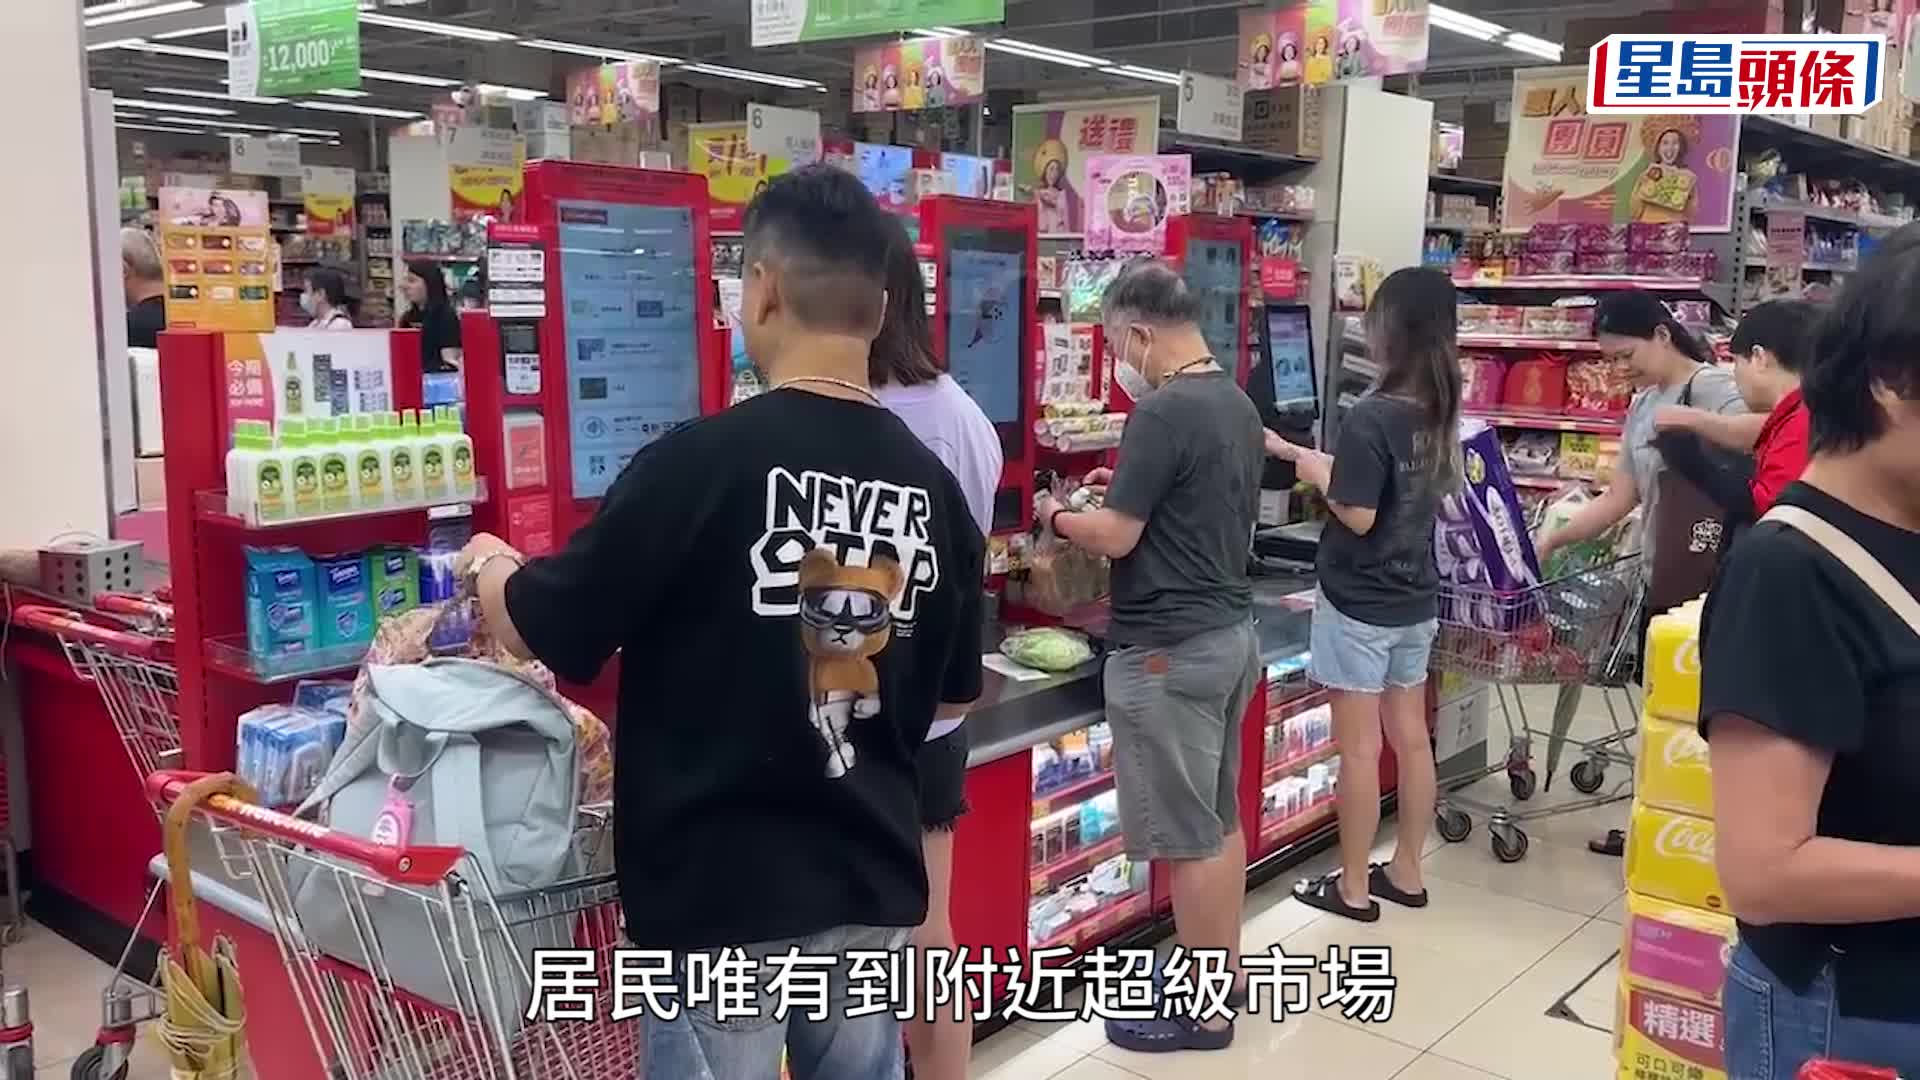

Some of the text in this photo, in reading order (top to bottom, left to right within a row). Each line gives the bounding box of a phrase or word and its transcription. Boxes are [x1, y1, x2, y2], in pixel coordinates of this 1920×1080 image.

[268, 39, 329, 73] 12,000
[1183, 76, 1194, 102] 5
[752, 108, 763, 129] 6
[1079, 114, 1137, 151] 送禮
[766, 467, 932, 543] NEVER
[1642, 1000, 1715, 1049] 精選
